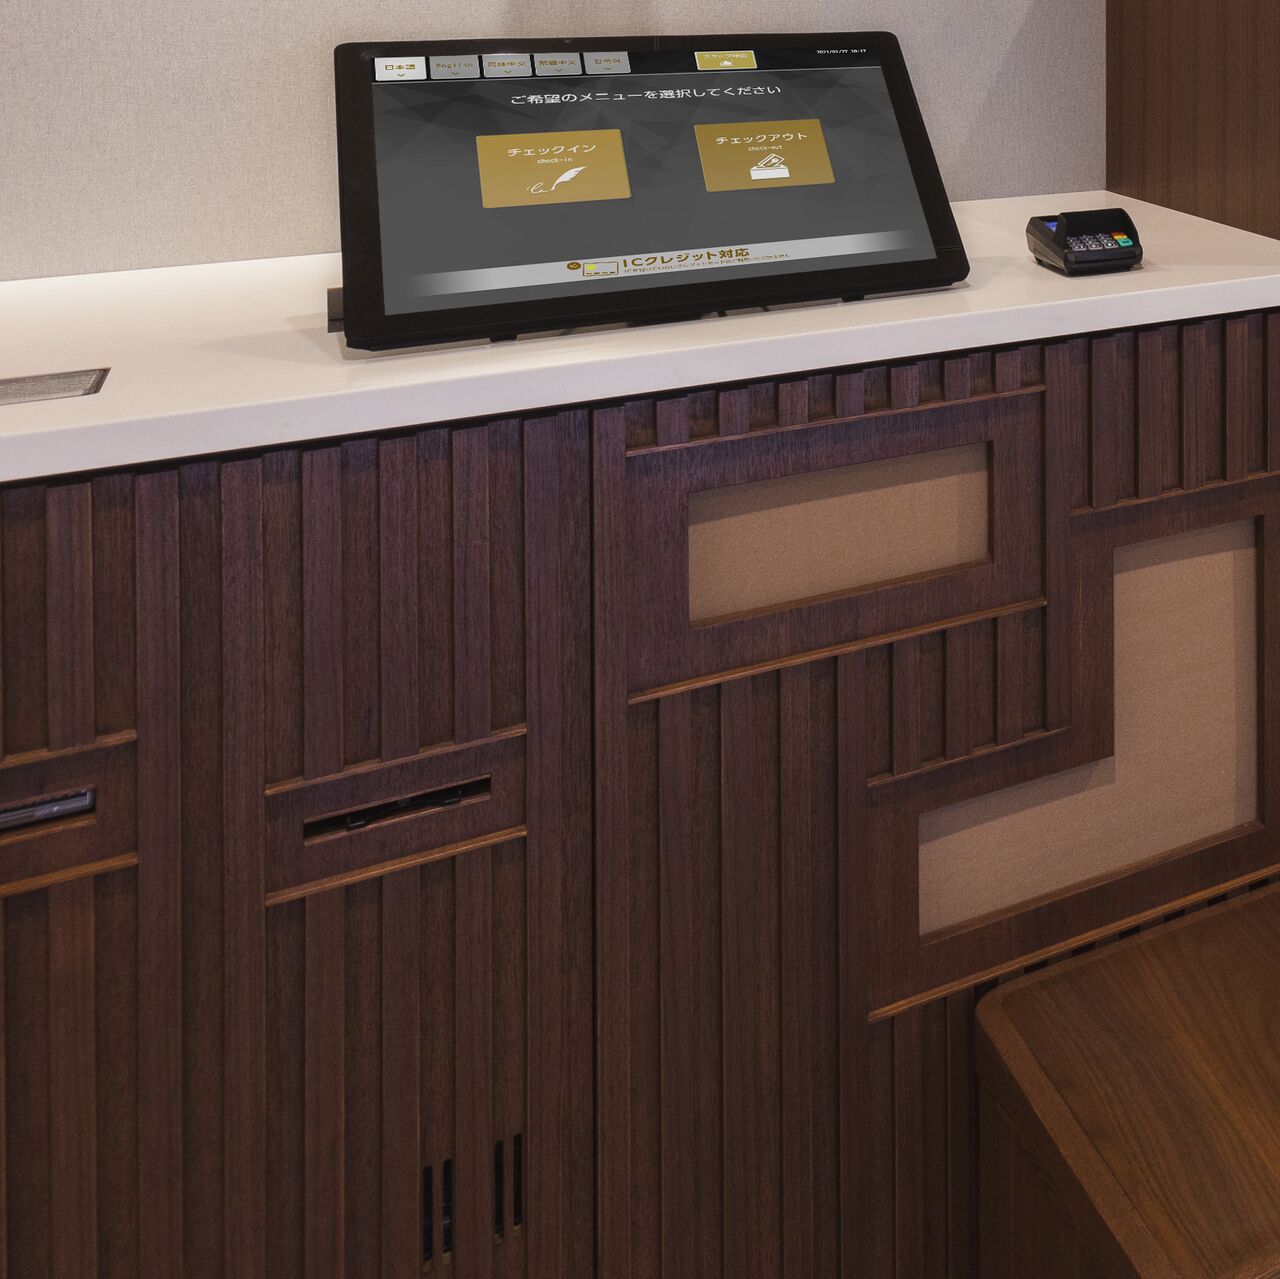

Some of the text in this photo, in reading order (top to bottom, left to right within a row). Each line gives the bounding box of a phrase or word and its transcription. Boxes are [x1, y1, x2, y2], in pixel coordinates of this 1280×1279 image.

[384, 63, 416, 71] 日本語
[435, 61, 474, 70] English
[510, 85, 782, 105] ご希望のメニューを選択してください
[715, 132, 808, 145] チェックアウト
[507, 144, 597, 157] チェックイン
[537, 157, 573, 165] check-in
[622, 247, 750, 268] ICクレジット対応
